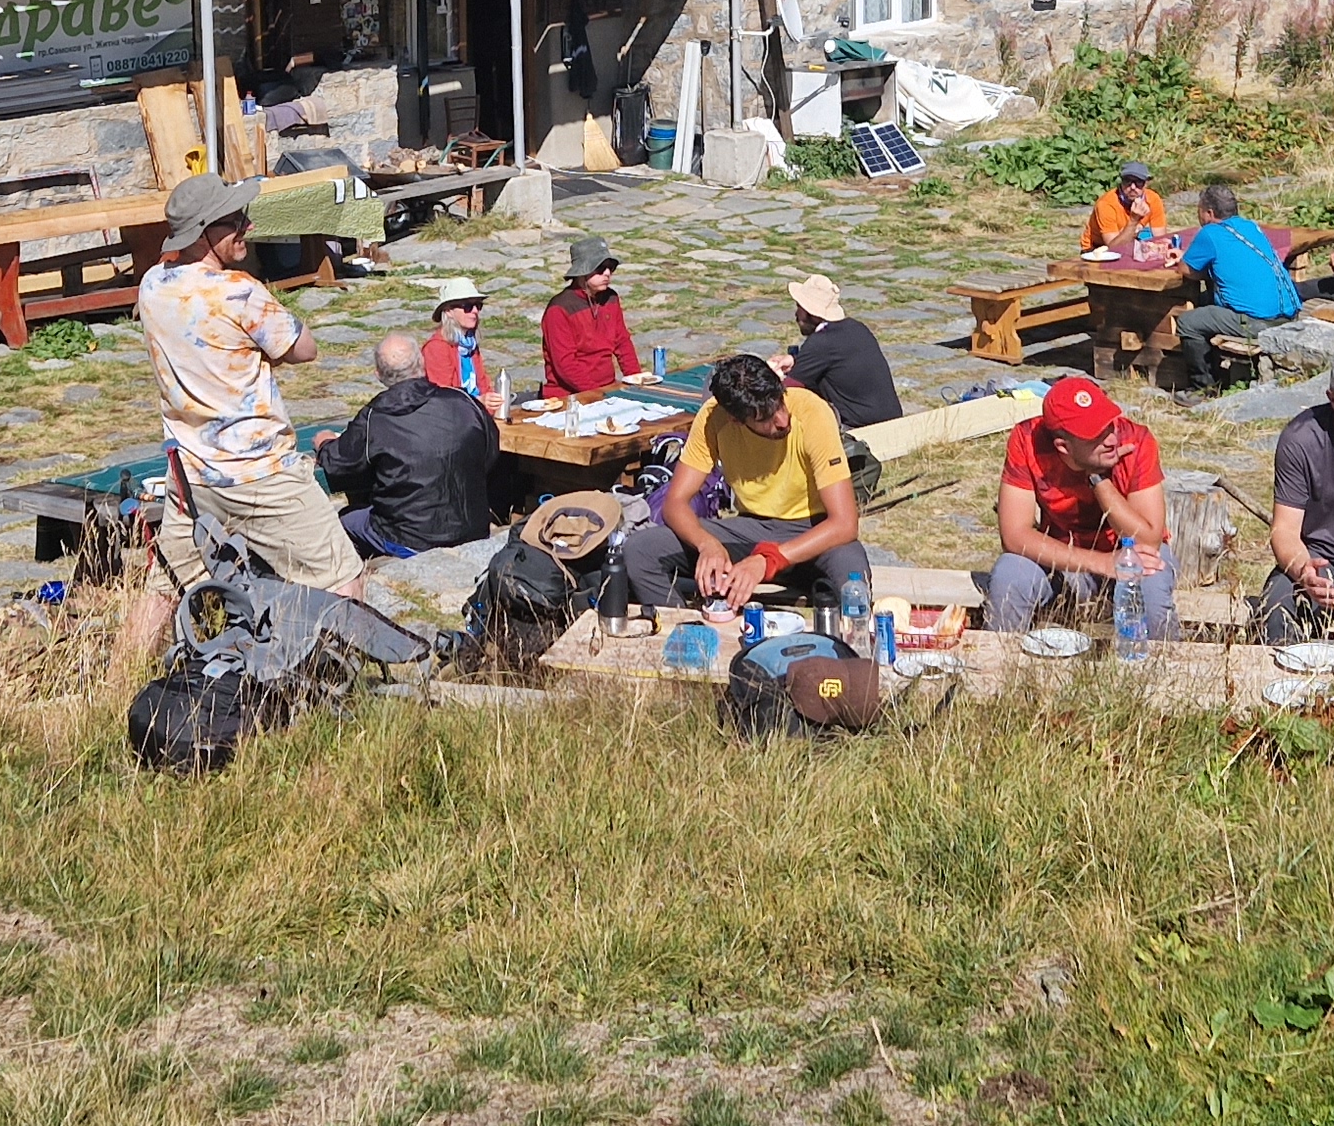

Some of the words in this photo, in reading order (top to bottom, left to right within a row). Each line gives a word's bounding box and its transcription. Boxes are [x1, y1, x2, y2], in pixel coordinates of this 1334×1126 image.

[106, 58, 136, 73] 0887
[141, 54, 164, 68] 841
[166, 49, 189, 63] 220
